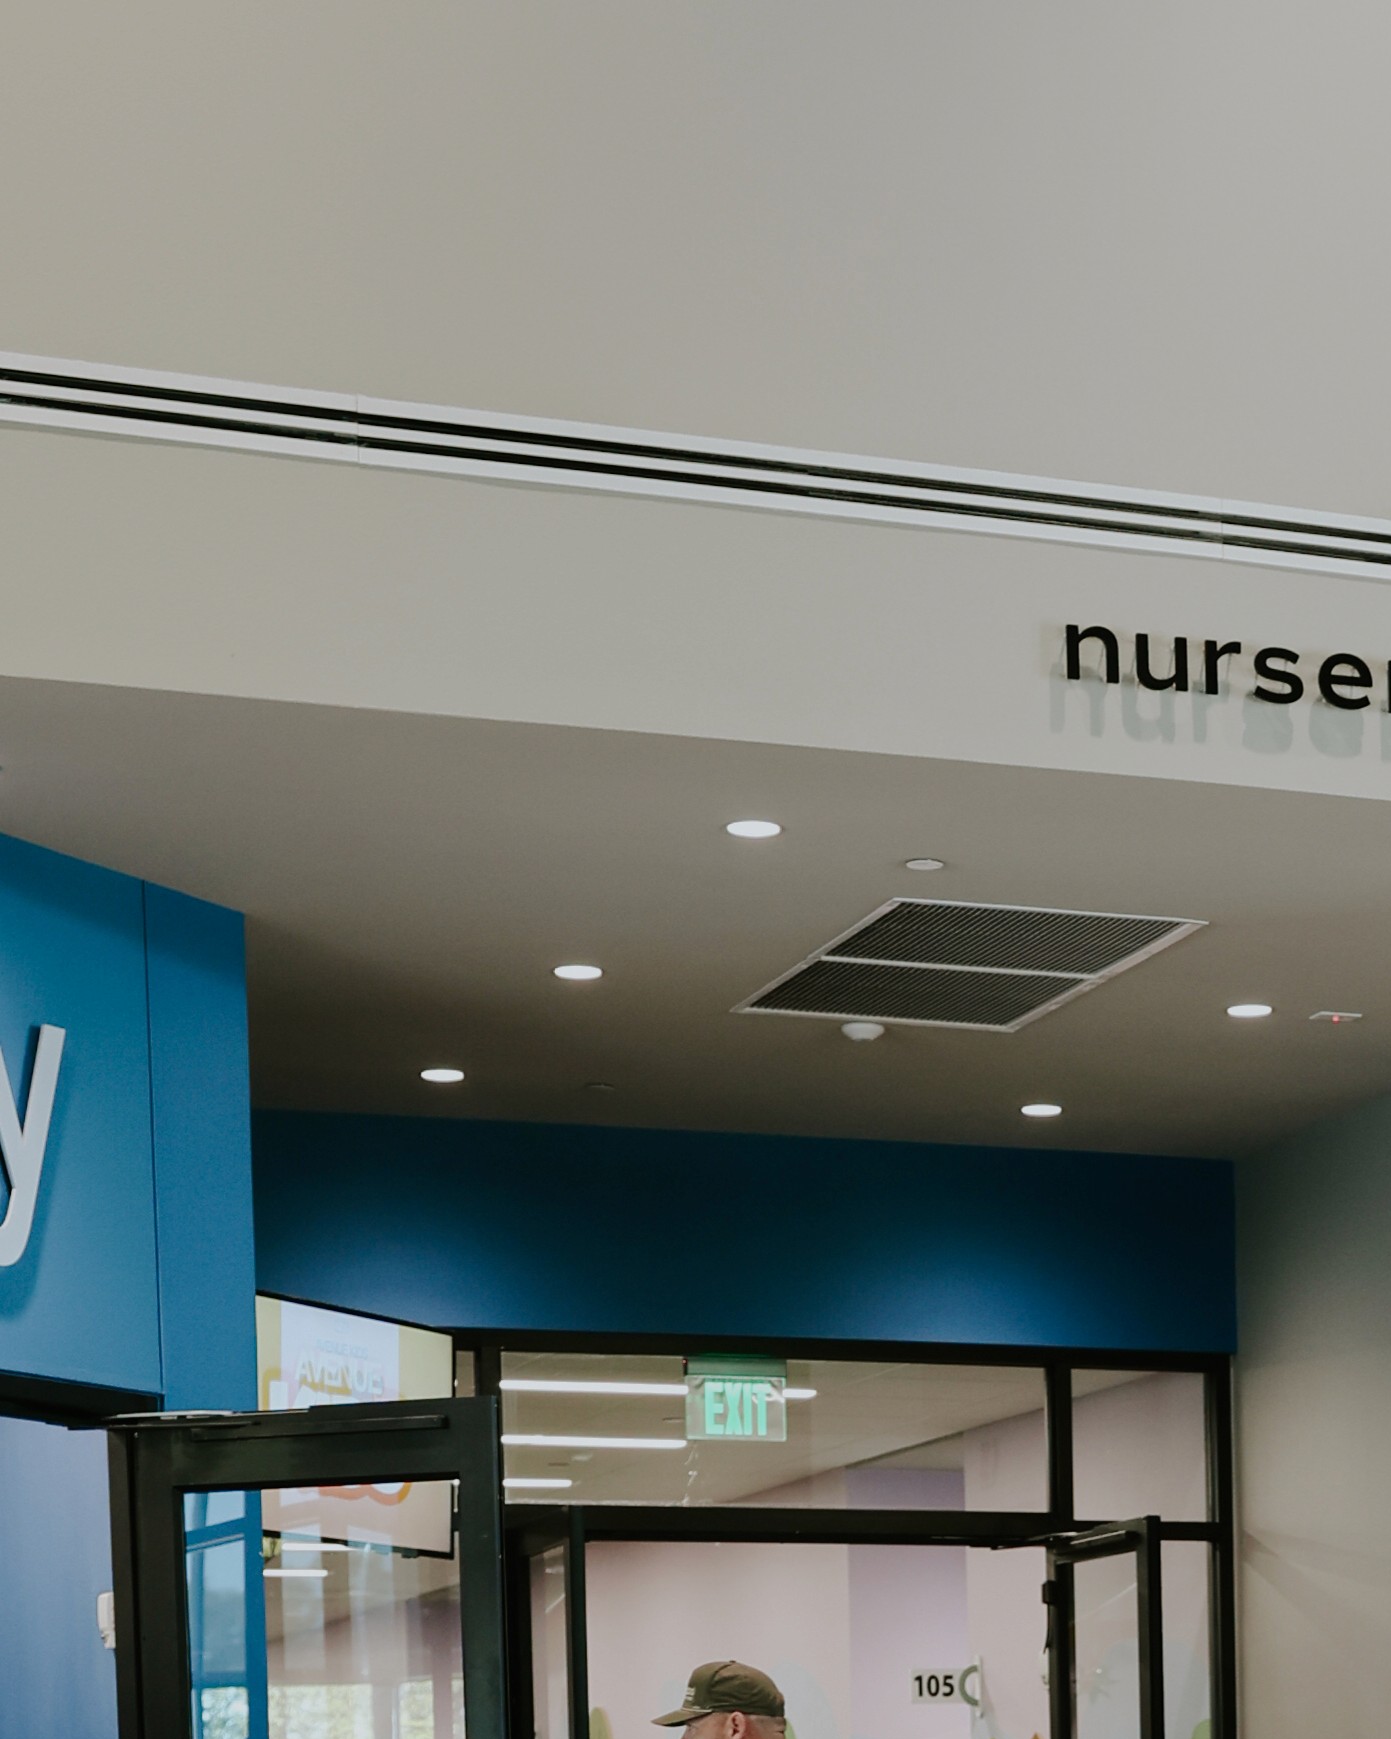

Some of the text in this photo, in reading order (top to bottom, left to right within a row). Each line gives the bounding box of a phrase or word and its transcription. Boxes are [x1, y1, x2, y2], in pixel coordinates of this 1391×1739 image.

[295, 1349, 384, 1396] AVENUE
[704, 1381, 772, 1436] EXIT
[914, 1674, 955, 1697] 105
